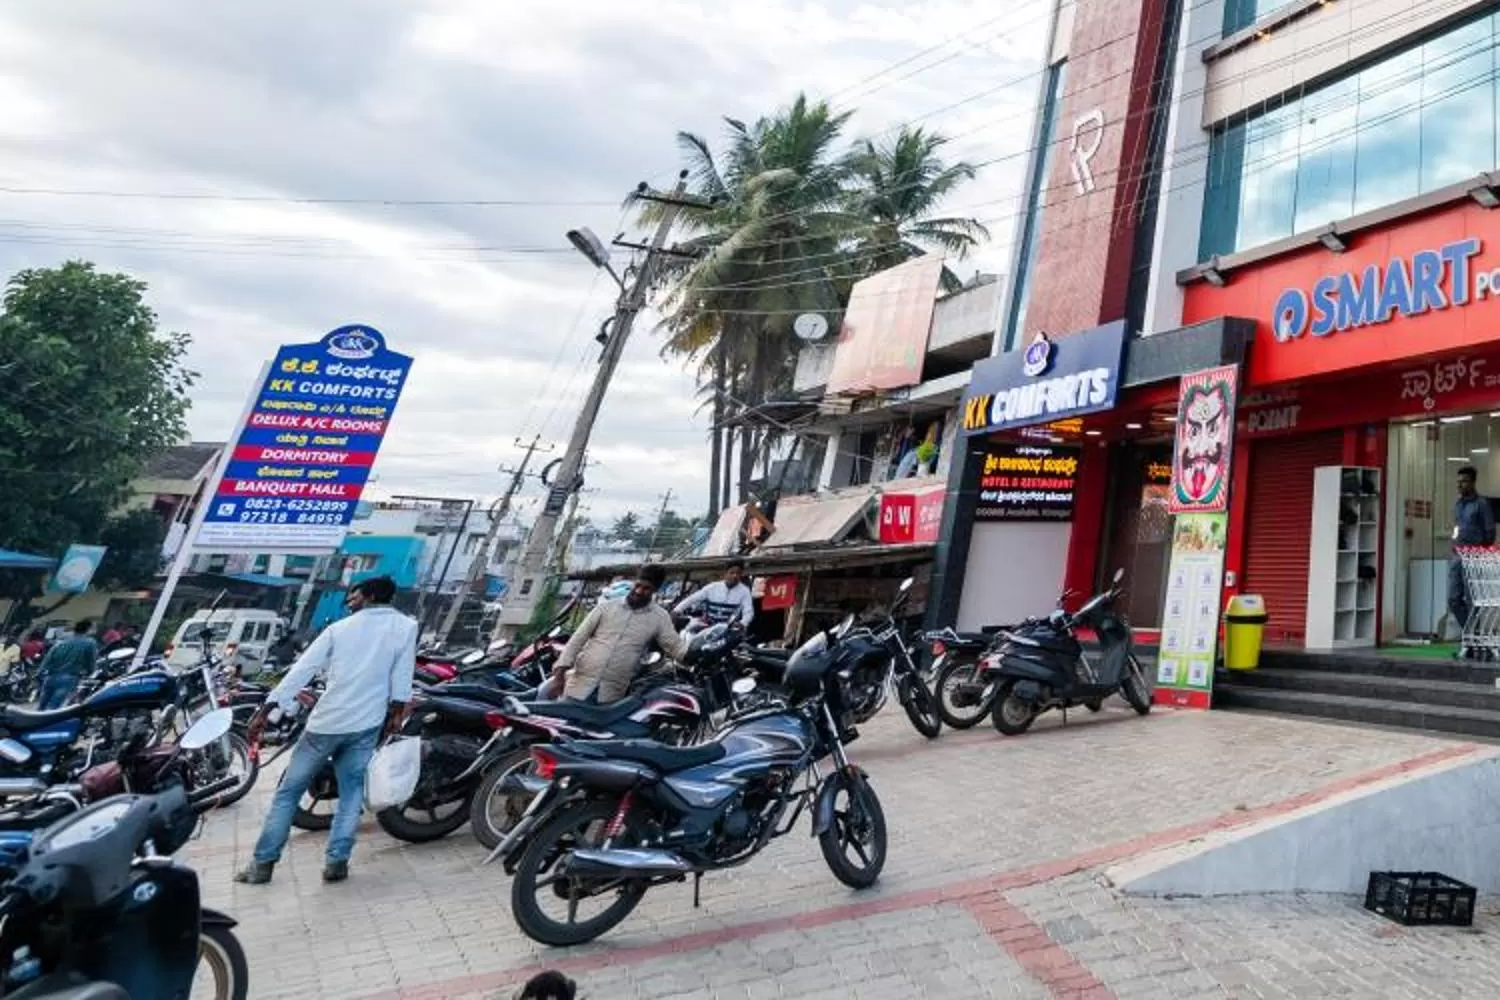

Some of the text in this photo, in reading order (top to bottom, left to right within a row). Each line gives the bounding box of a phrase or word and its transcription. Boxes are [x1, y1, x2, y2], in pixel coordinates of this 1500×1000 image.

[1311, 238, 1481, 337] SMART
[270, 379, 397, 400] KK COMFORTS
[963, 367, 1109, 429] KK COMFORTS
[252, 413, 384, 432] DELUX A/C ROOMS
[260, 449, 349, 464] DORMITORY
[234, 480, 347, 496] BANQUET HALL
